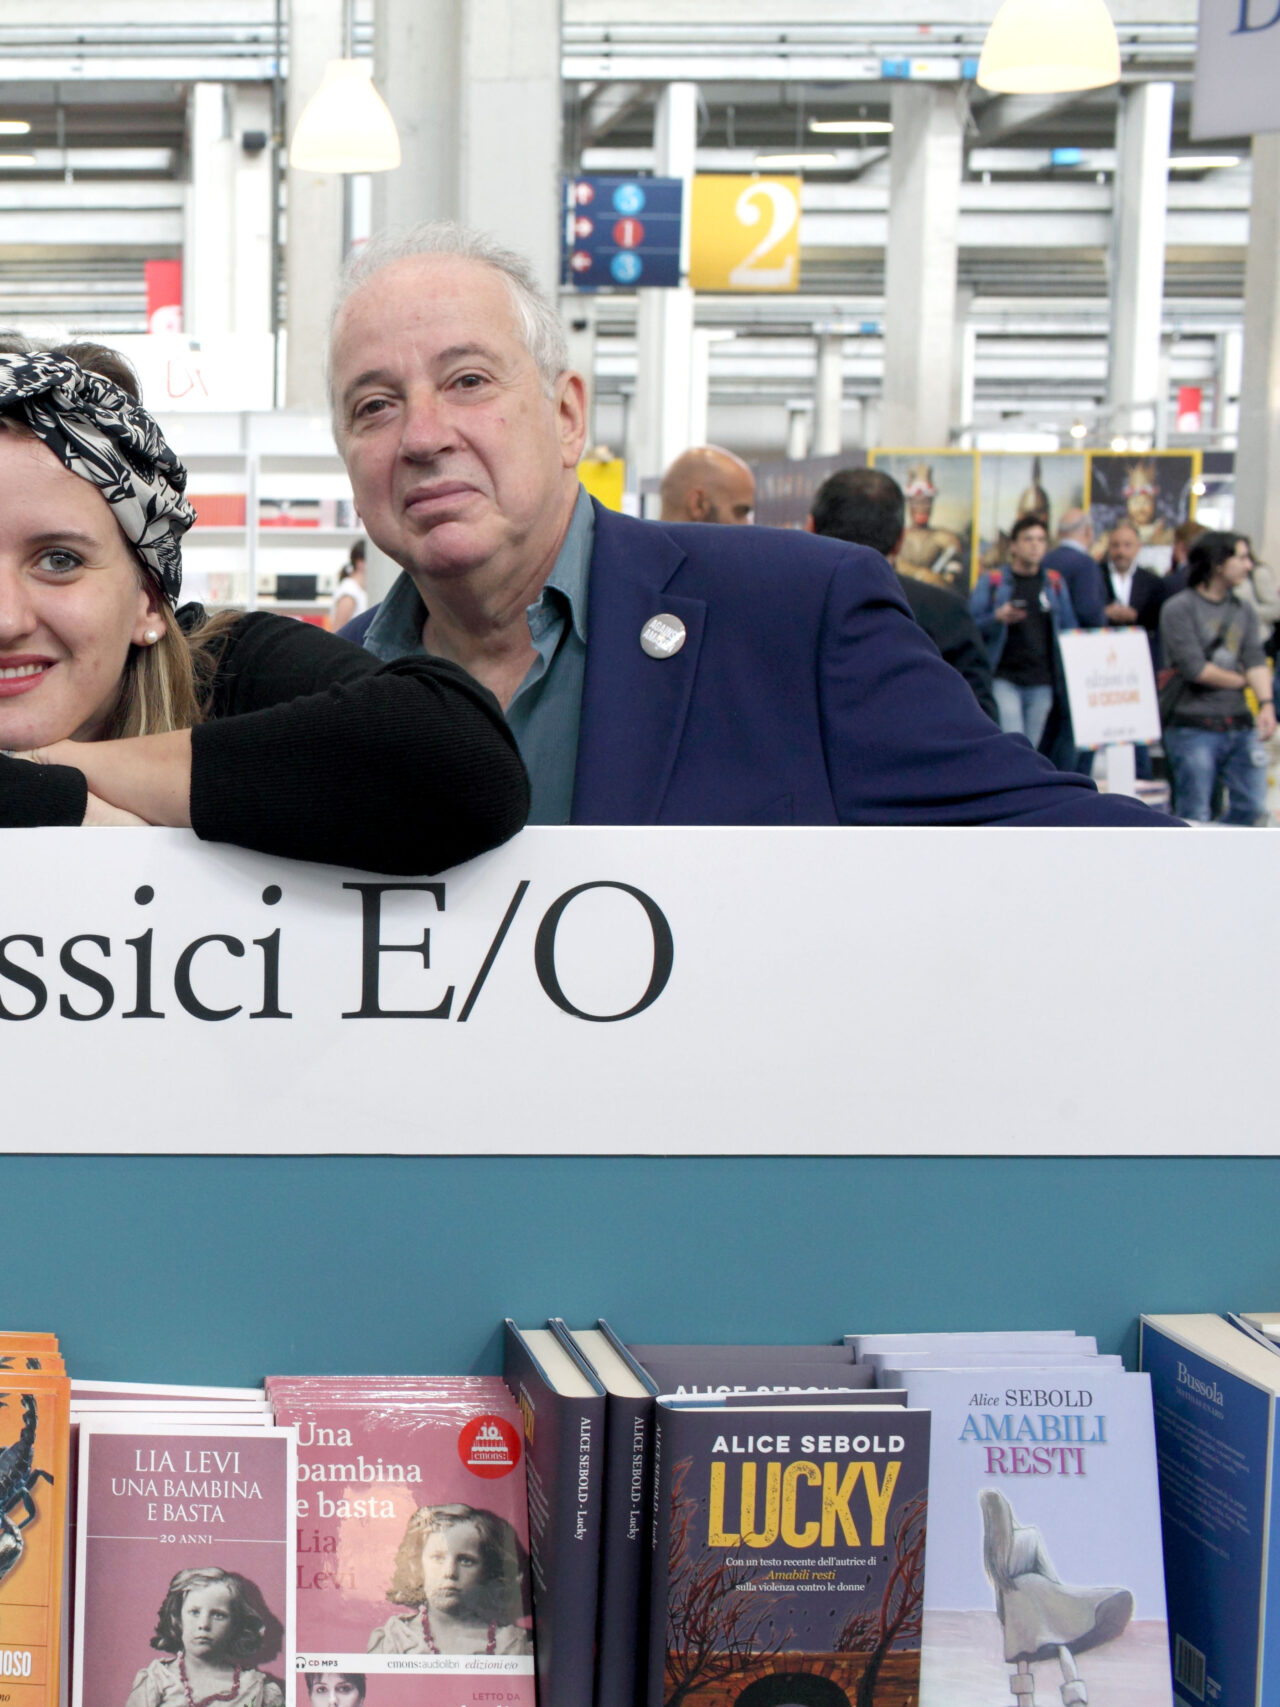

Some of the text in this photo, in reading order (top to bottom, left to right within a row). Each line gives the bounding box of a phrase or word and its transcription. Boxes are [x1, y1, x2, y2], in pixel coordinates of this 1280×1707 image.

[728, 181, 797, 285] 2
[341, 880, 674, 1022] E/O
[1177, 1360, 1223, 1407] Bussola
[968, 1389, 1093, 1408] Alice SEBOLD
[292, 1421, 353, 1447] Una
[958, 1413, 1107, 1443] AMABILI
[711, 1435, 905, 1453] ALICE SEBOLD
[135, 1449, 241, 1474] LIA LEVI
[296, 1455, 423, 1483] bambina
[983, 1446, 1087, 1475] RESTI
[111, 1478, 263, 1500] UNA BAMBINA
[574, 1416, 592, 1540] ALICE SEBOLD Lucky
[627, 1416, 644, 1540] ALICE SEBOLD Lucky
[147, 1503, 226, 1523] E BASTA
[296, 1491, 396, 1519] e basta
[708, 1460, 902, 1548] LUCKY
[159, 1534, 212, 1544] 20 ANNI
[296, 1529, 337, 1553] Lia
[725, 1557, 745, 1566] Con
[760, 1558, 782, 1566] testo
[783, 1558, 817, 1566] recente
[817, 1557, 866, 1566] dell'autrice
[867, 1556, 877, 1566] di
[296, 1565, 357, 1590] Levi
[736, 1582, 865, 1591] sulla violenza contro le donne
[766, 1569, 836, 1580] Amabili resti
[465, 1659, 503, 1670] edizioni
[472, 1692, 520, 1701] LETTO DA
